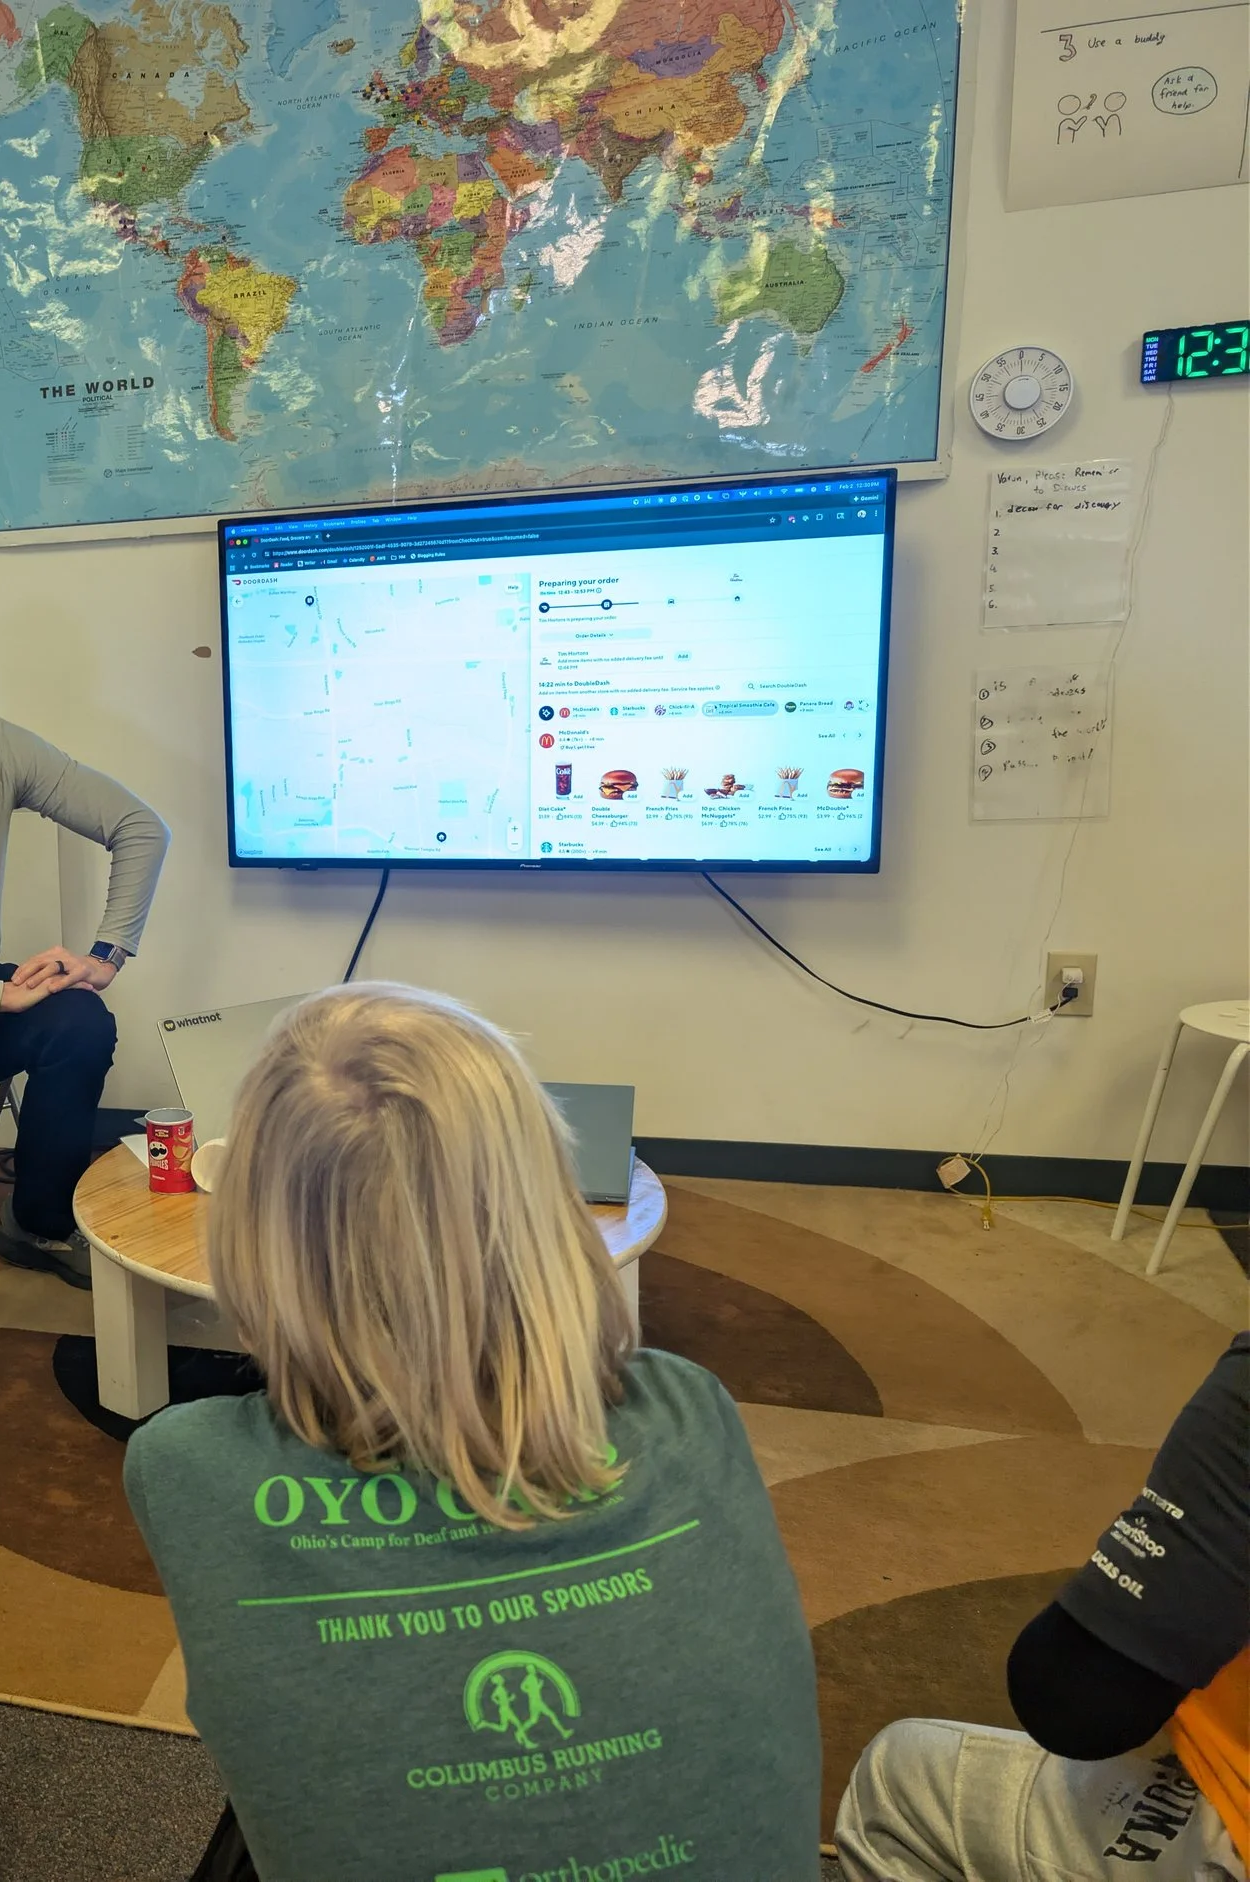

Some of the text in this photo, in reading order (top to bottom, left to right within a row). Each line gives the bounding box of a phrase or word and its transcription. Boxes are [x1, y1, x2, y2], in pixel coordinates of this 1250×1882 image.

[835, 21, 937, 54] PACIFIC OCEAN
[1058, 33, 1077, 62] 3
[1087, 38, 1106, 49] Use
[1134, 31, 1166, 46] buddy
[654, 49, 703, 66] MONGOLIA
[111, 70, 190, 80] CANADA
[1163, 75, 1182, 86] Ask
[1160, 88, 1188, 99] friend
[277, 92, 341, 107] NORTH ATLANTIC
[296, 101, 322, 111] OCEAN
[623, 103, 677, 117] CHINA
[763, 279, 804, 290] AUSTRALIA
[233, 289, 268, 300] BRAZIL
[573, 316, 660, 331] INDIAN OCEAN
[318, 323, 382, 337] SOUTH ATLANTIC
[337, 333, 363, 342] OCEAN
[1019, 350, 1025, 361] 0
[1038, 353, 1046, 362] 5
[1177, 326, 1250, 378] 12:3
[1052, 364, 1063, 375] 10
[39, 376, 155, 399] THE WORLD
[1058, 383, 1069, 392] 15
[82, 394, 114, 403] POLITICAL
[975, 393, 985, 402] 45
[1016, 426, 1026, 435] 30
[1033, 487, 1044, 495] to
[243, 578, 278, 586] DOORDASH
[538, 577, 620, 588] Preparing your order
[176, 1011, 222, 1029] whatnot
[253, 1472, 419, 1527] OYO
[289, 1523, 478, 1553] Ohio's Camp for Deaf and
[1118, 1574, 1145, 1600] OIL
[317, 1567, 654, 1645] THANK YOU TO OUR SPONSORS
[406, 1727, 663, 1790] COLUMBUS RUNNING
[485, 1767, 605, 1803] COMPANY
